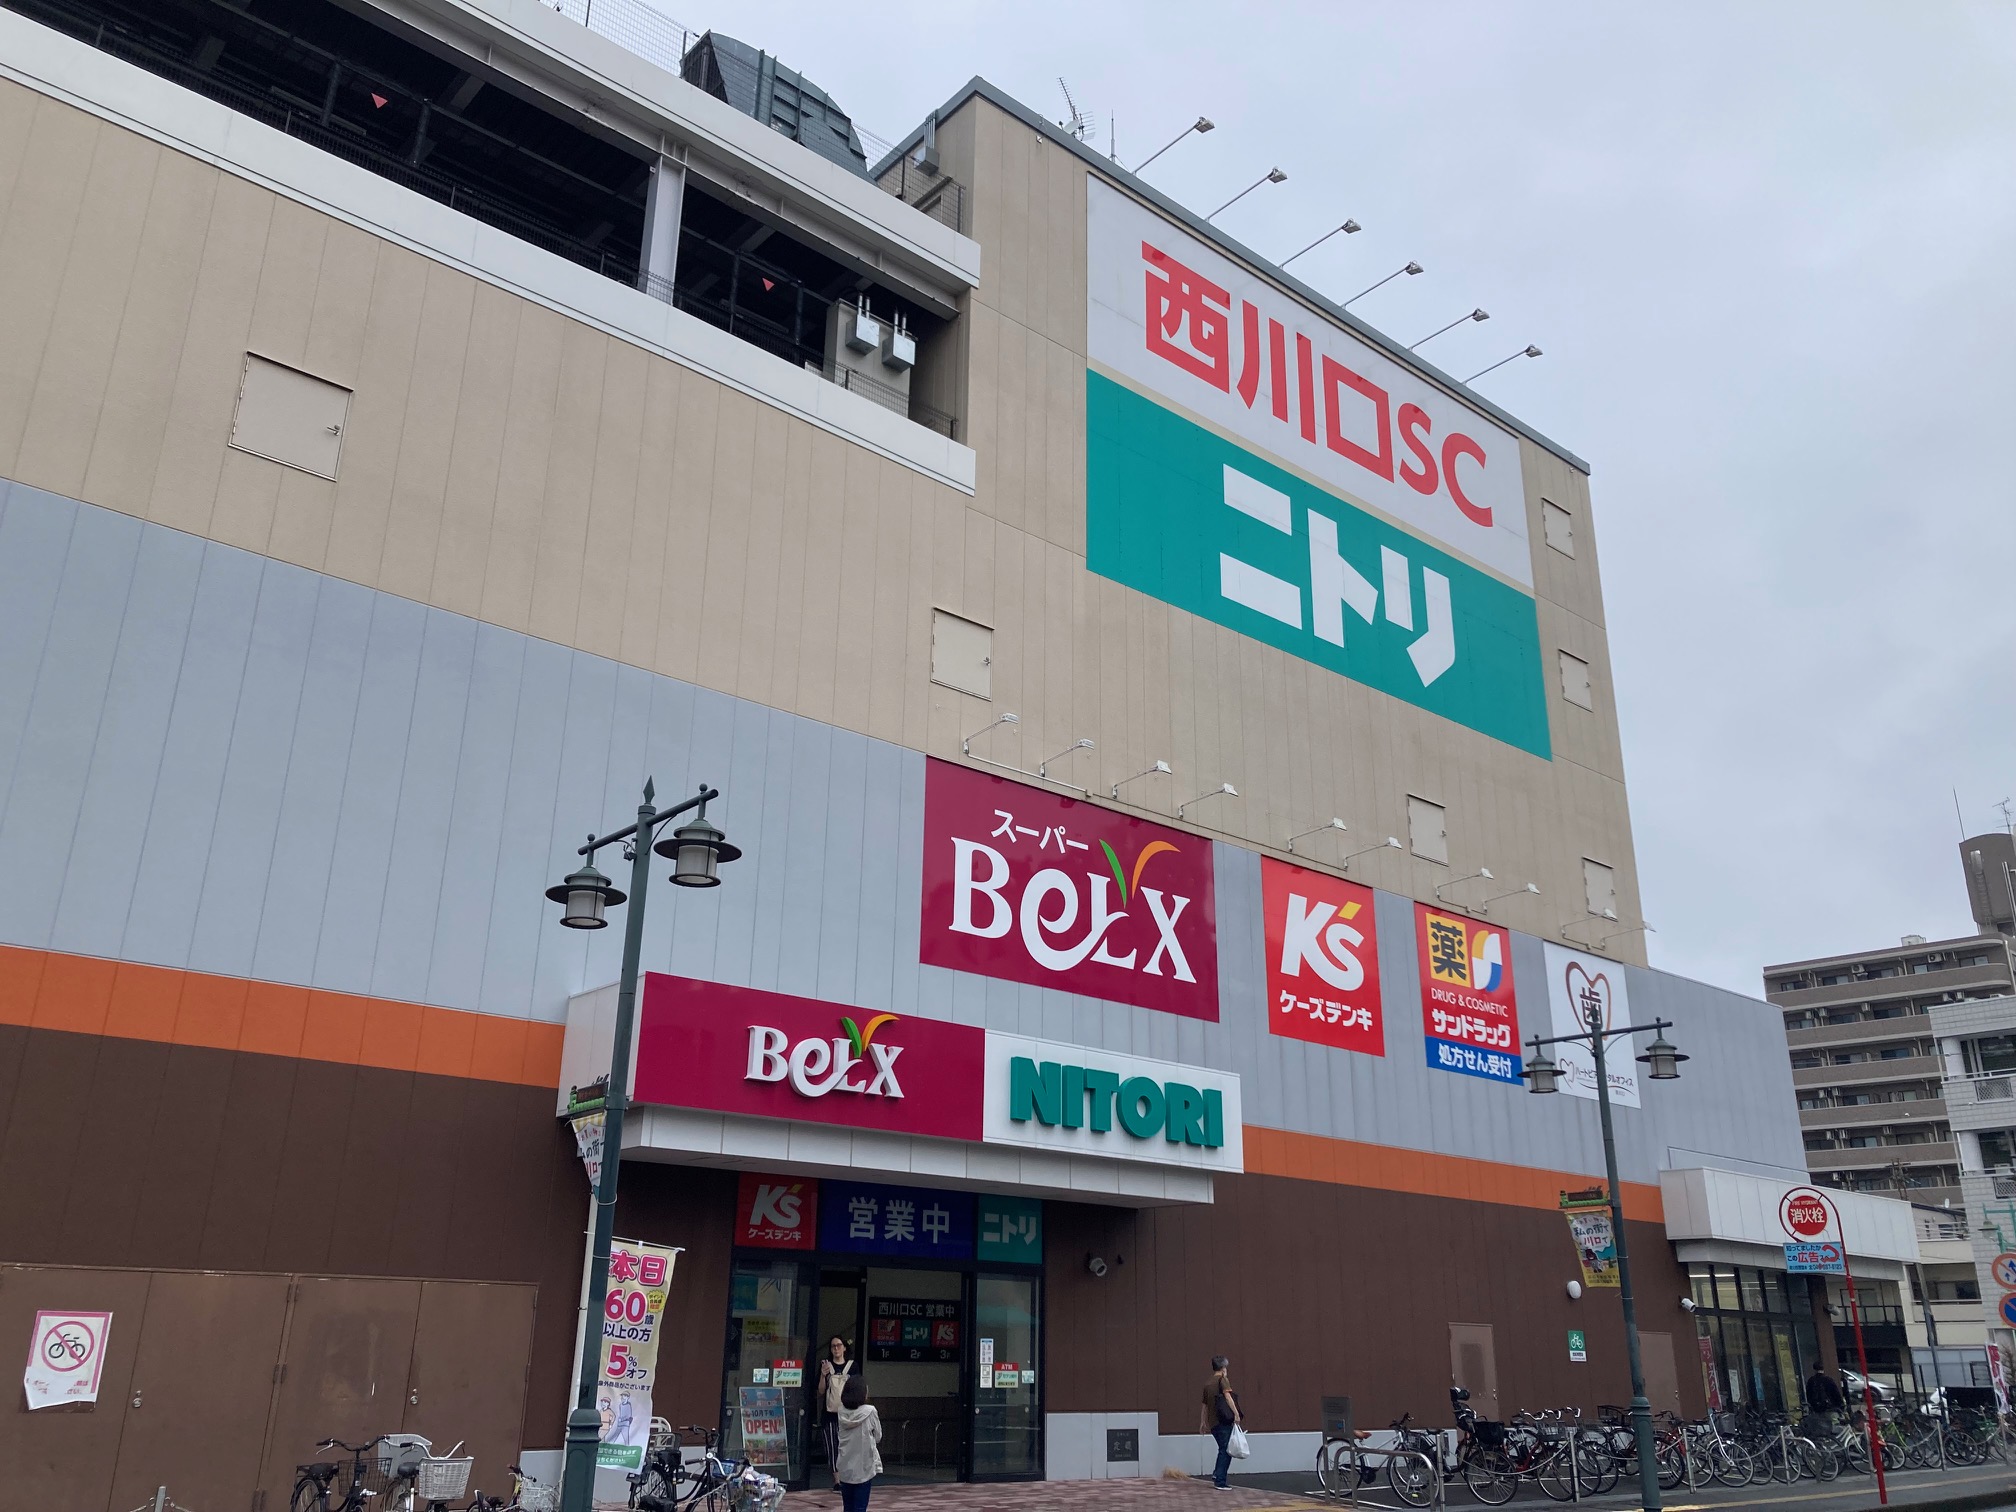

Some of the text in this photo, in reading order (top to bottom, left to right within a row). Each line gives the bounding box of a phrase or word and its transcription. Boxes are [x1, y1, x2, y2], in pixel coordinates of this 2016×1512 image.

[1142, 240, 1493, 528] 西川口SC
[1220, 463, 1456, 688] ニトリ
[991, 808, 1089, 854] スーパー
[1430, 919, 1468, 980] 薬
[1279, 989, 1373, 1033] ケーズデンキ
[1430, 987, 1457, 1005] DRUG
[1465, 995, 1509, 1018] COSMETIC
[1431, 1007, 1512, 1048] サンドラッグ
[1438, 1042, 1512, 1079] 処方せん受付
[1010, 1055, 1224, 1148] NITORI
[848, 1196, 950, 1244] 営業中
[983, 1212, 1036, 1246] ニトリ
[1790, 1207, 1825, 1224] 消火栓
[748, 1228, 802, 1242] ケーズデンキ
[609, 1250, 667, 1287] 本日
[879, 1302, 955, 1318] 西川口SC 営業中
[603, 1322, 651, 1342] 以上の方
[904, 1326, 928, 1340] ニトリ
[781, 1360, 796, 1368] ATM
[881, 1348, 890, 1358] 1F
[910, 1349, 921, 1359] 2F
[940, 1349, 950, 1359] 3F
